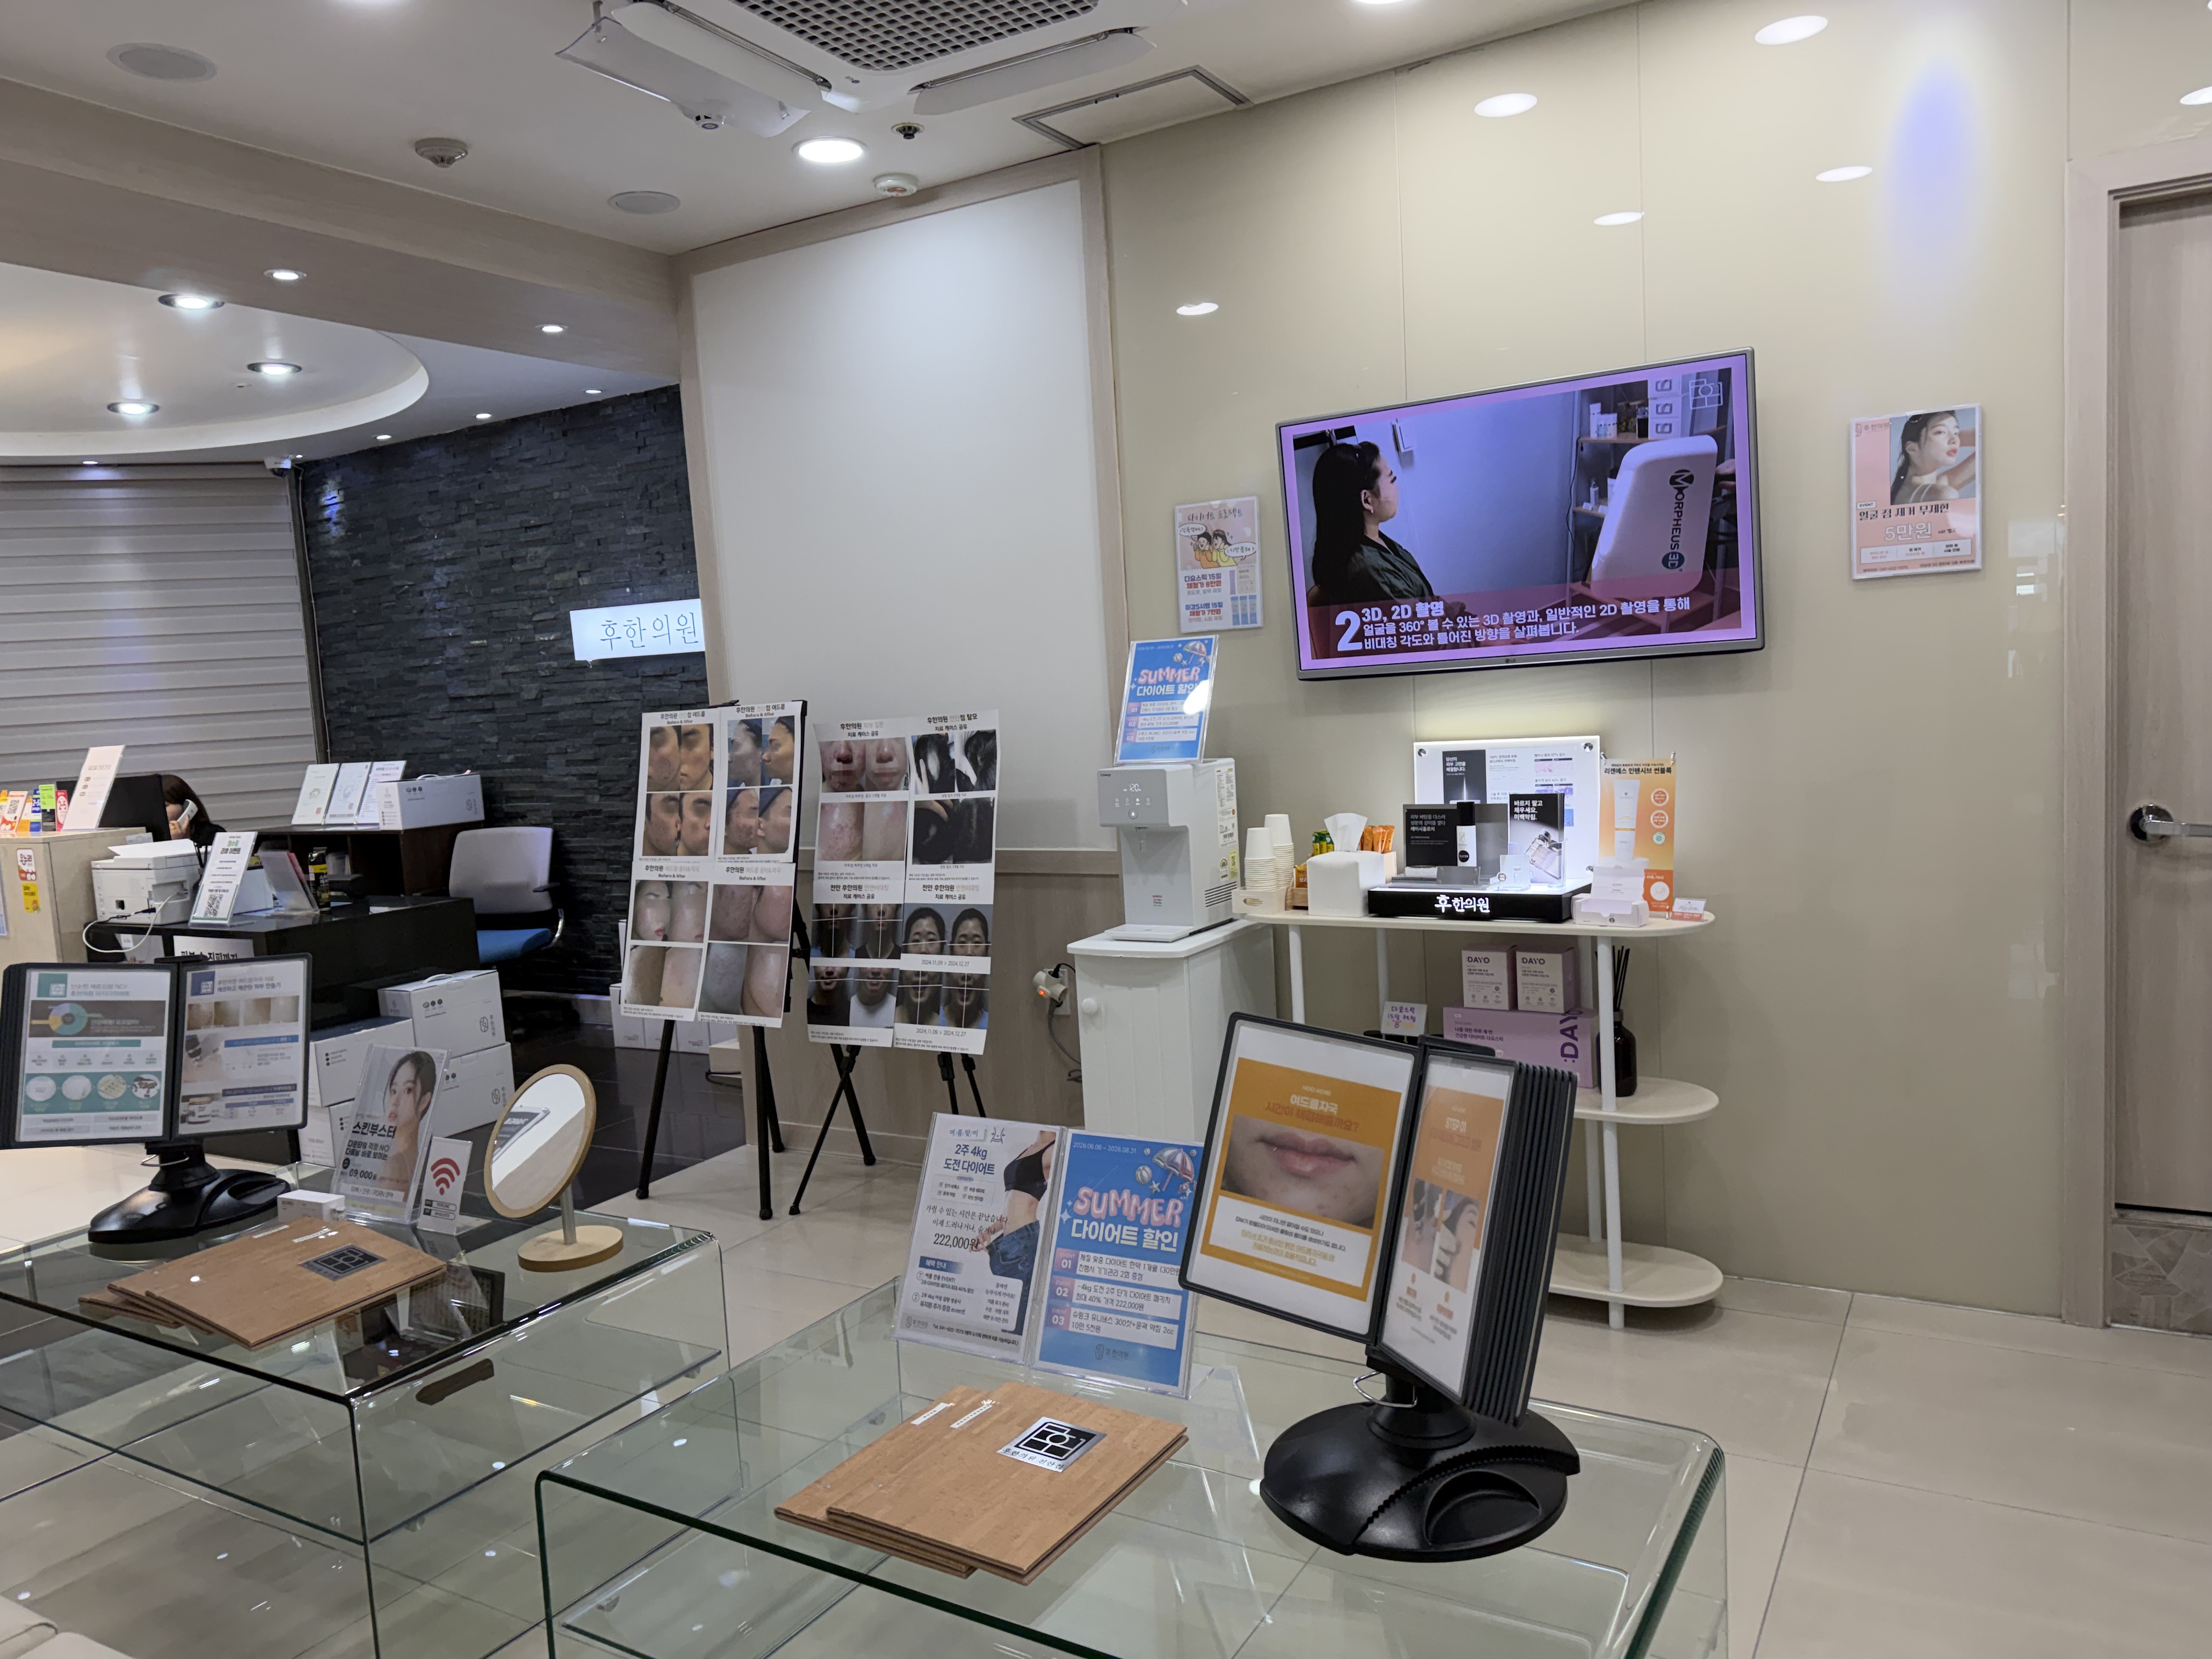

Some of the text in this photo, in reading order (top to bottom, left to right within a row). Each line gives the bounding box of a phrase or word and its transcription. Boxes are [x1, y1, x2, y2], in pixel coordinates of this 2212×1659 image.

[1859, 503, 1949, 521] 얼굴 점 제거 무제한
[1884, 522, 1932, 541] 5만원
[1362, 601, 1444, 623] 3D, 2D 촬영
[1363, 622, 1396, 636] 얼굴을
[1427, 618, 1439, 631] 볼
[1442, 617, 1454, 630] 수
[1457, 616, 1480, 629] 있는
[1482, 613, 1499, 626] 3D
[1502, 610, 1542, 625] 촬영과,
[1545, 604, 1596, 621] 일반적인
[1599, 604, 1617, 616] 2D
[1621, 599, 1660, 615] 촬영을
[1663, 596, 1690, 612] 통해
[600, 612, 698, 651] 후한의원
[1335, 610, 1363, 652] 2
[1364, 621, 1579, 650] 비대칭 각도와 틀어진 방향을 살펴봅니다.
[1138, 666, 1200, 685] SUMMER
[1137, 685, 1175, 697] 다이어트
[1435, 895, 1491, 913] 후한의원
[1290, 1094, 1338, 1115] 여드름자국
[352, 1121, 397, 1139] 스킨부스터
[1445, 1116, 1460, 1131] STEP
[348, 1139, 390, 1152] 다운타임 걱정 NO
[955, 1144, 988, 1160] 2주 4kg
[372, 1152, 388, 1160] 보이는
[943, 1158, 995, 1175] 도전 다이어트
[946, 1208, 957, 1217] 있는
[959, 1210, 977, 1220] 시간은
[1073, 1187, 1184, 1229] SUMMER
[933, 1218, 944, 1228] 이제
[933, 1233, 980, 1252] 222,000원
[1071, 1218, 1178, 1253] 다이어트 할인
[936, 1261, 947, 1269] 안내
[1062, 1259, 1071, 1268] 01
[1079, 1263, 1094, 1273] 진행시
[1097, 1266, 1119, 1277] 기기관리
[1105, 1257, 1127, 1268] 다이어트
[1056, 1286, 1069, 1297] 02
[1088, 1295, 1101, 1304] 40%
[1093, 1285, 1104, 1295] 도전
[1106, 1287, 1115, 1296] 2주
[1117, 1289, 1127, 1299] 단기
[1130, 1291, 1151, 1301] 다이어트
[1052, 1315, 1064, 1325] 03
[1071, 1322, 1084, 1330] 10만
[1091, 1313, 1113, 1324] 유니버스
[1163, 1326, 1175, 1335] 2cc
